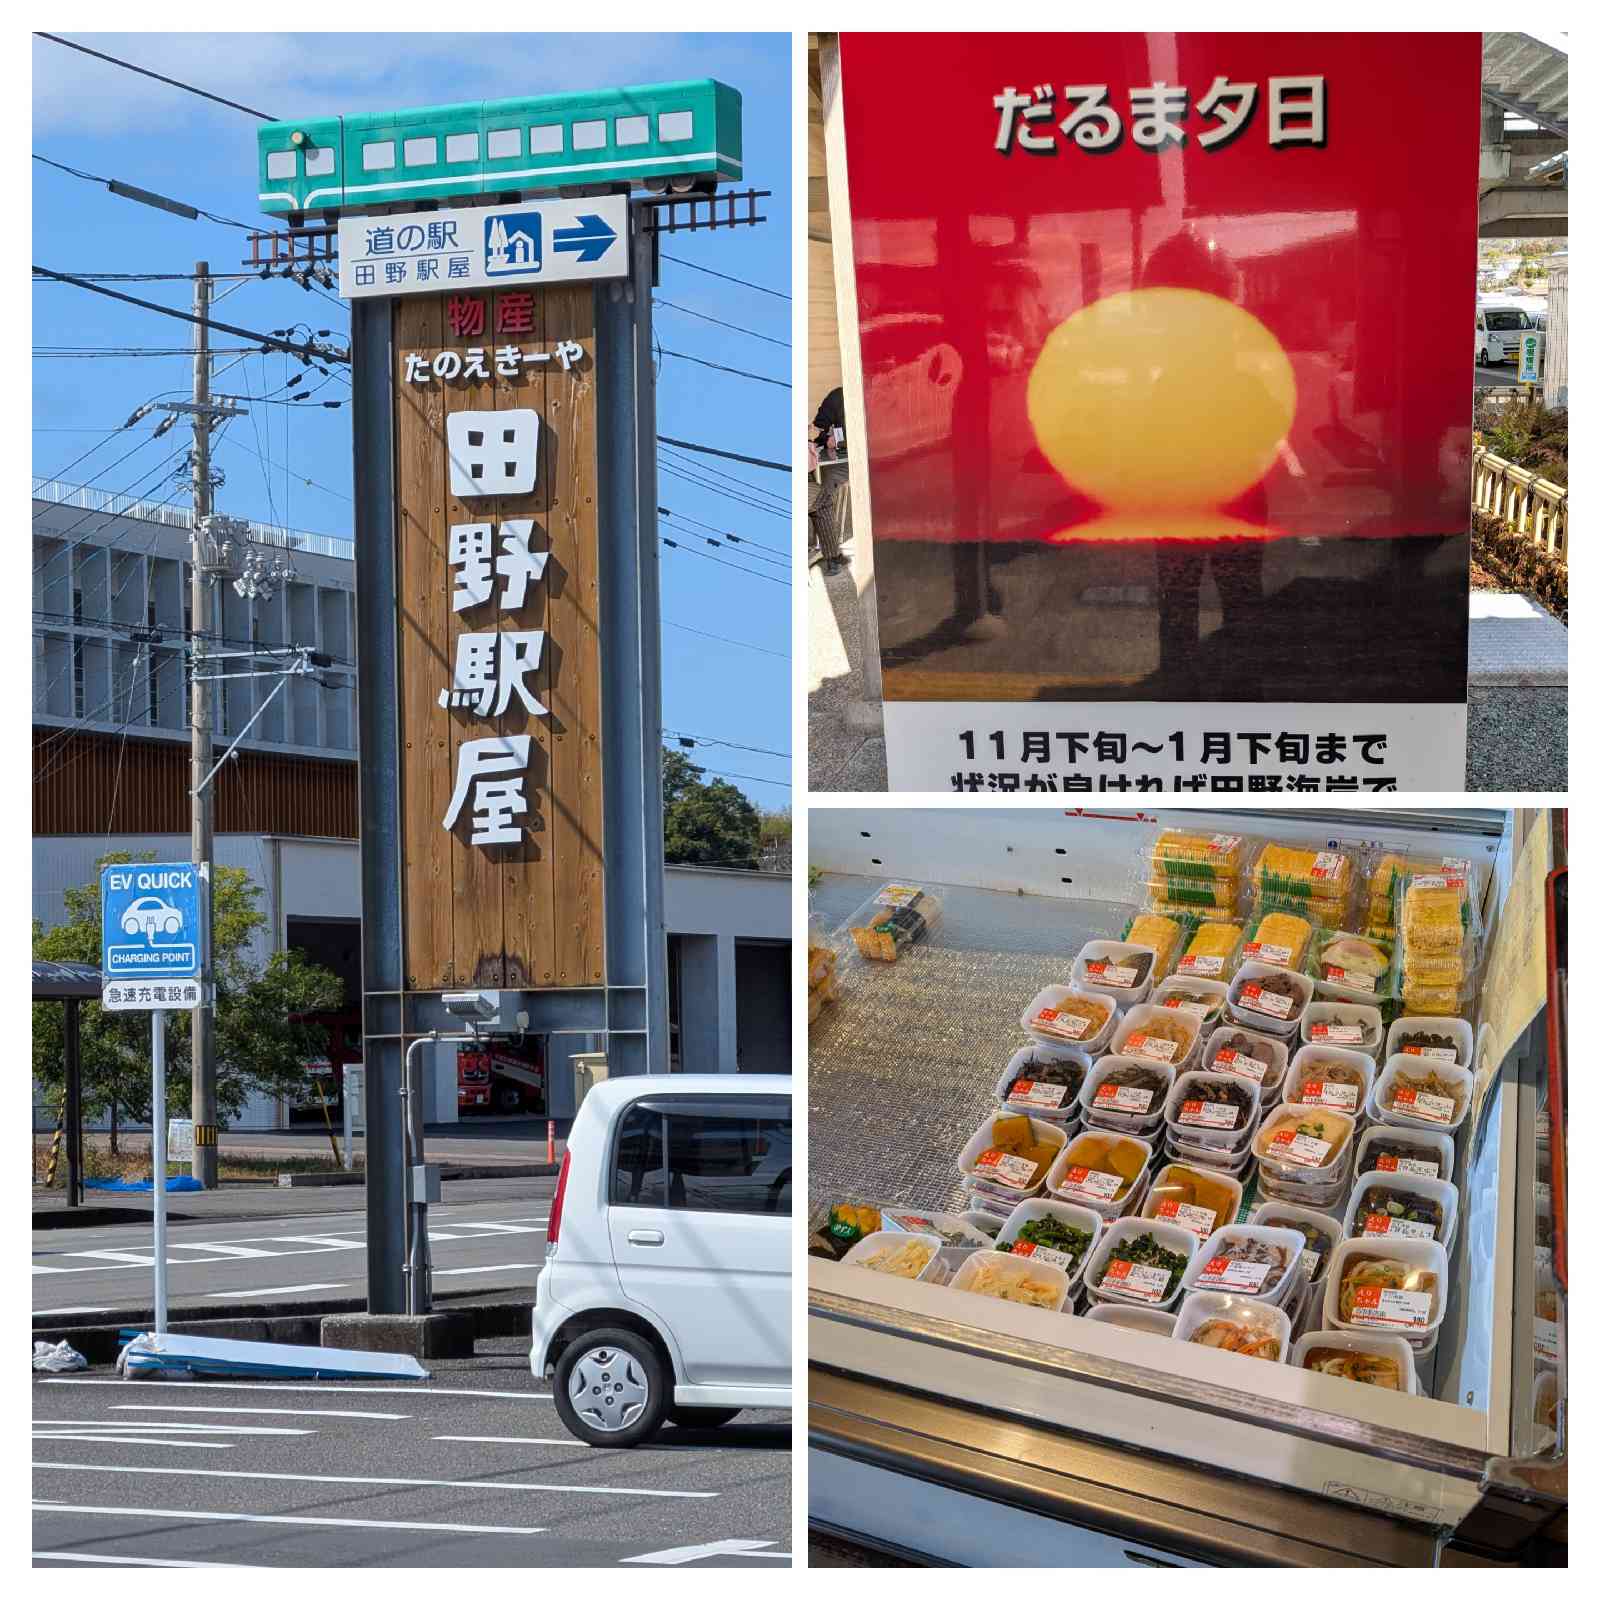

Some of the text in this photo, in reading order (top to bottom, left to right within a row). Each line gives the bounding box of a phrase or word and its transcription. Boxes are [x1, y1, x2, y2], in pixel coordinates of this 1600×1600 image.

[993, 76, 1327, 154] だるま夕日
[366, 220, 459, 256] 道の駅
[355, 256, 470, 286] 田野駅屋
[448, 294, 536, 337] 物産
[404, 340, 583, 384] たのえきーや
[438, 408, 550, 846] 田野駅屋
[110, 871, 193, 890] EV QUICK
[112, 951, 191, 964] CHARGING POINT
[108, 986, 197, 1002] 急速充電設備
